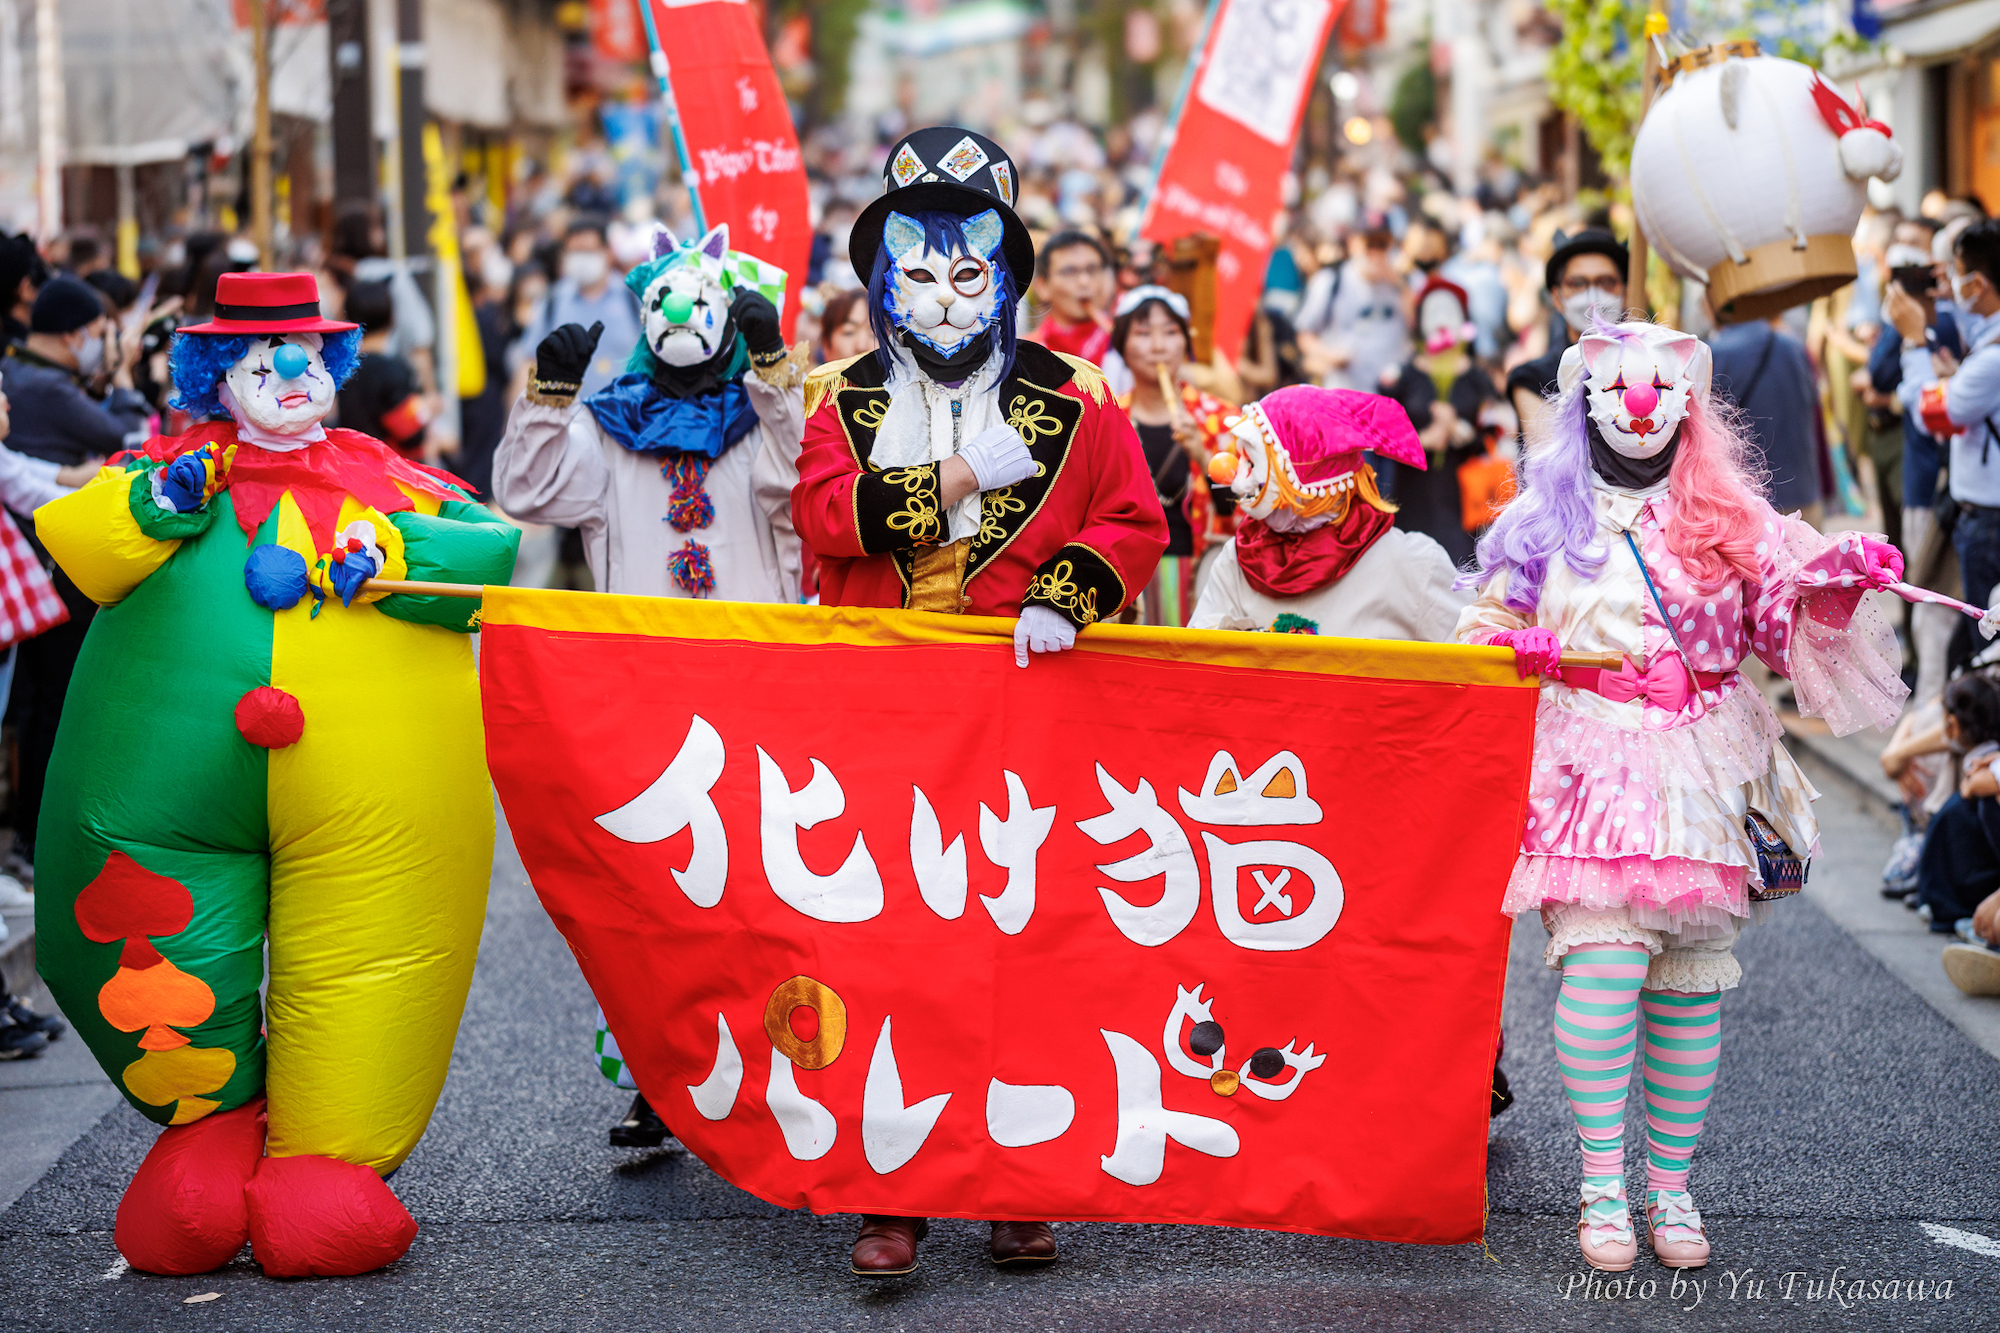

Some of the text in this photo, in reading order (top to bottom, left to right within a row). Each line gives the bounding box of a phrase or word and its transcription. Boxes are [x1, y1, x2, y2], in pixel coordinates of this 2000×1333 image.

[593, 712, 1345, 952] 化け猫
[686, 974, 1327, 1187] パレード
